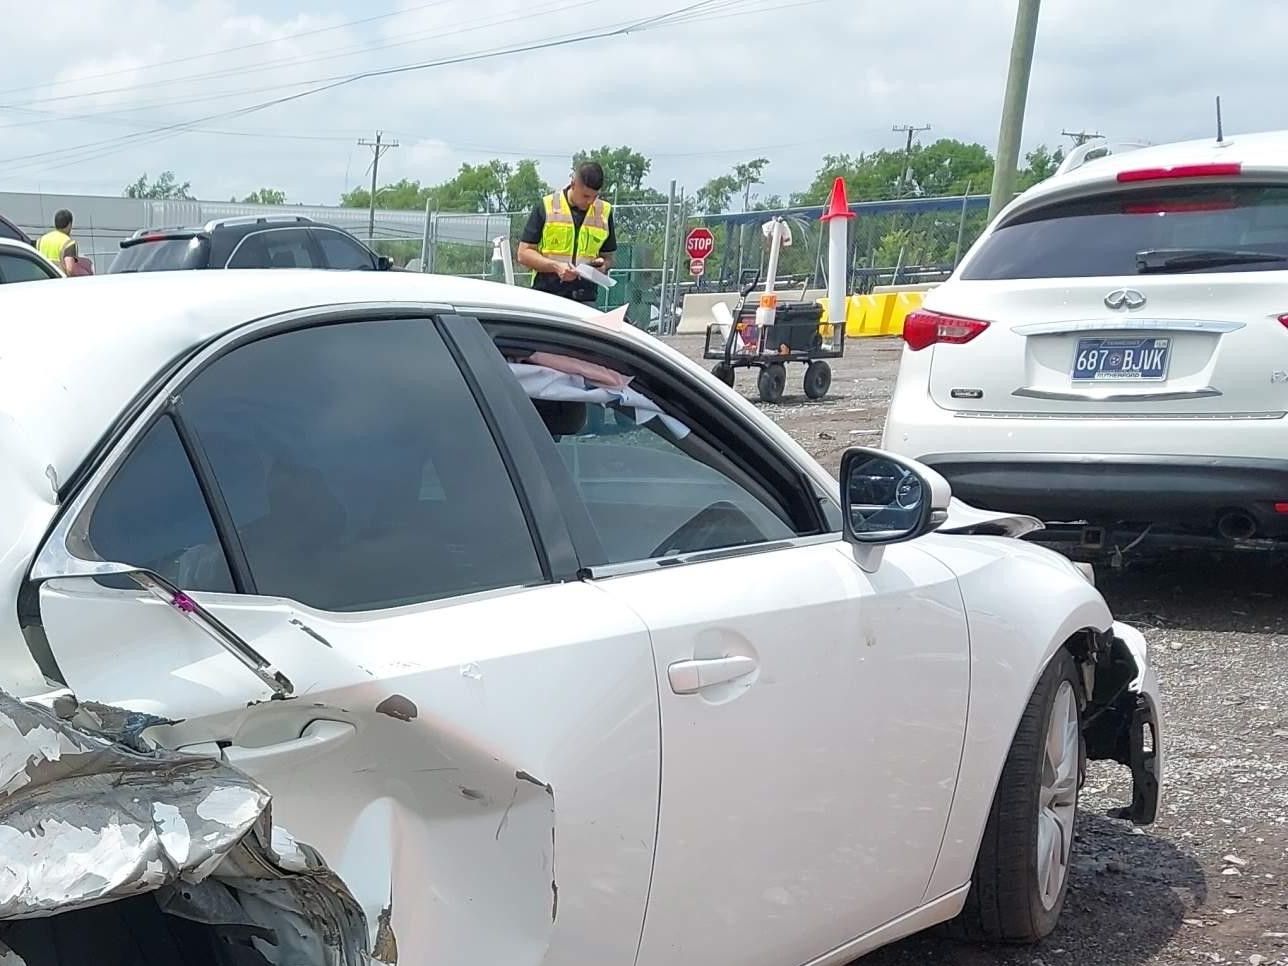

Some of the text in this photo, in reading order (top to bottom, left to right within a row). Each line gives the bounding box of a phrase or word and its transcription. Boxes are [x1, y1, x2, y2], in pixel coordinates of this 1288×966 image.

[687, 237, 711, 250] STOP
[1077, 349, 1165, 370] 687 BJVK
